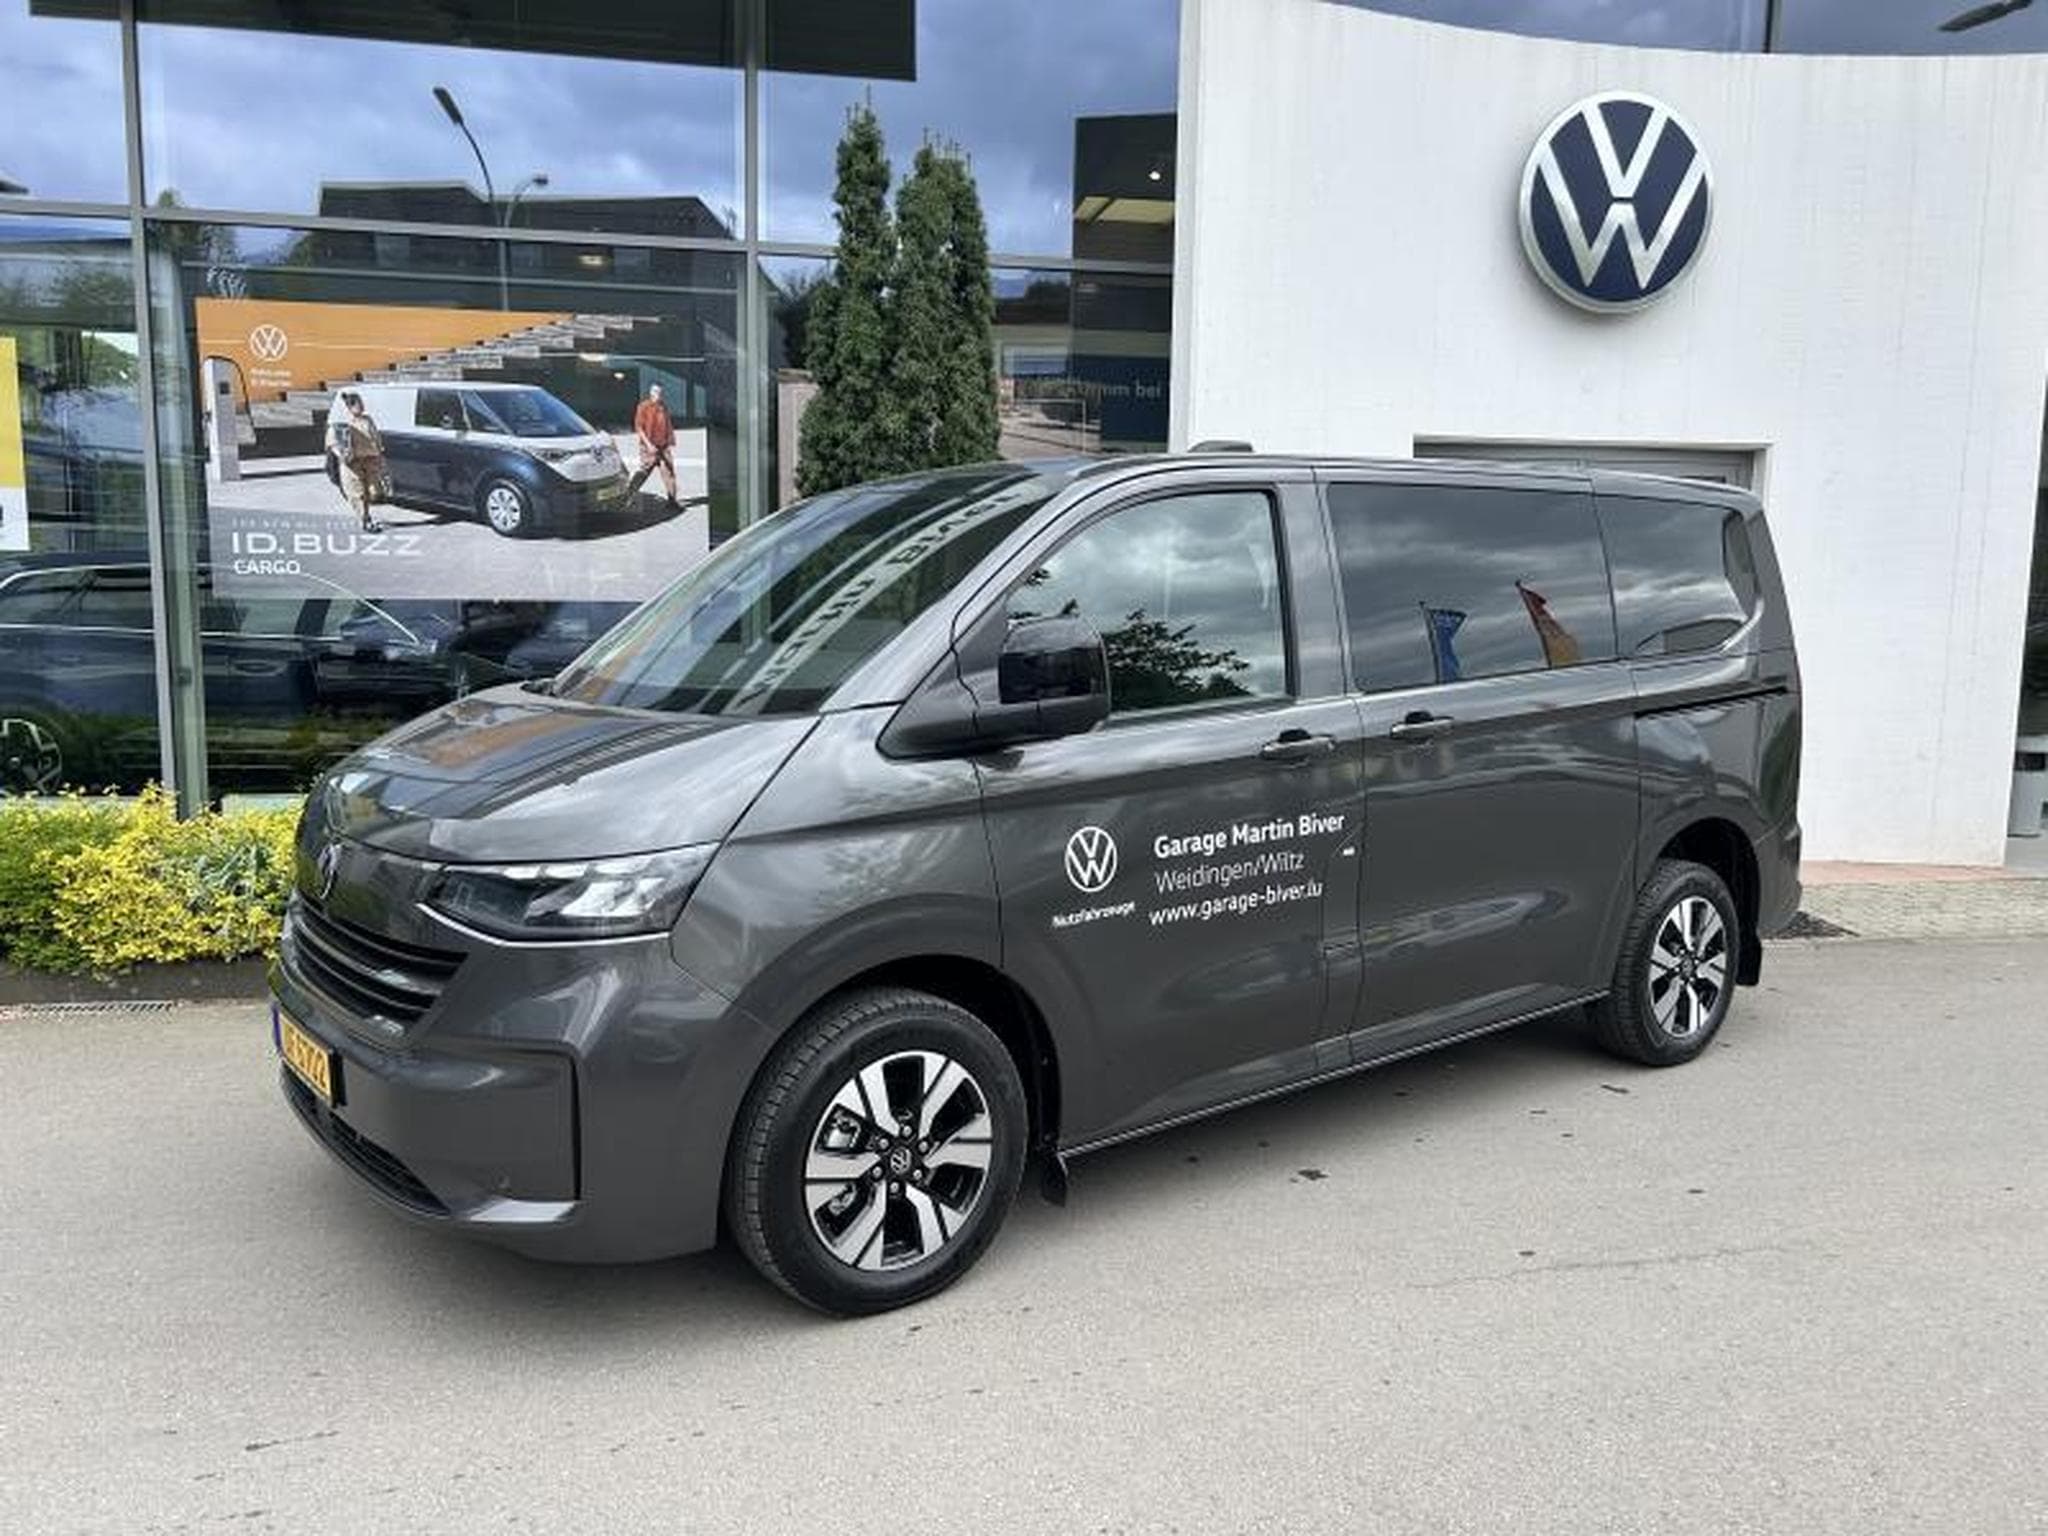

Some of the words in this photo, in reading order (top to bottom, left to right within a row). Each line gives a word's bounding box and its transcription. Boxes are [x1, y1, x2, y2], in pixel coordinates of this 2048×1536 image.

[233, 559, 301, 576] CARGO
[1154, 830, 1227, 859] Garage
[1232, 818, 1294, 846] Martin
[1299, 812, 1345, 837] Biver
[1149, 877, 1324, 926] www.garage-biver.lu
